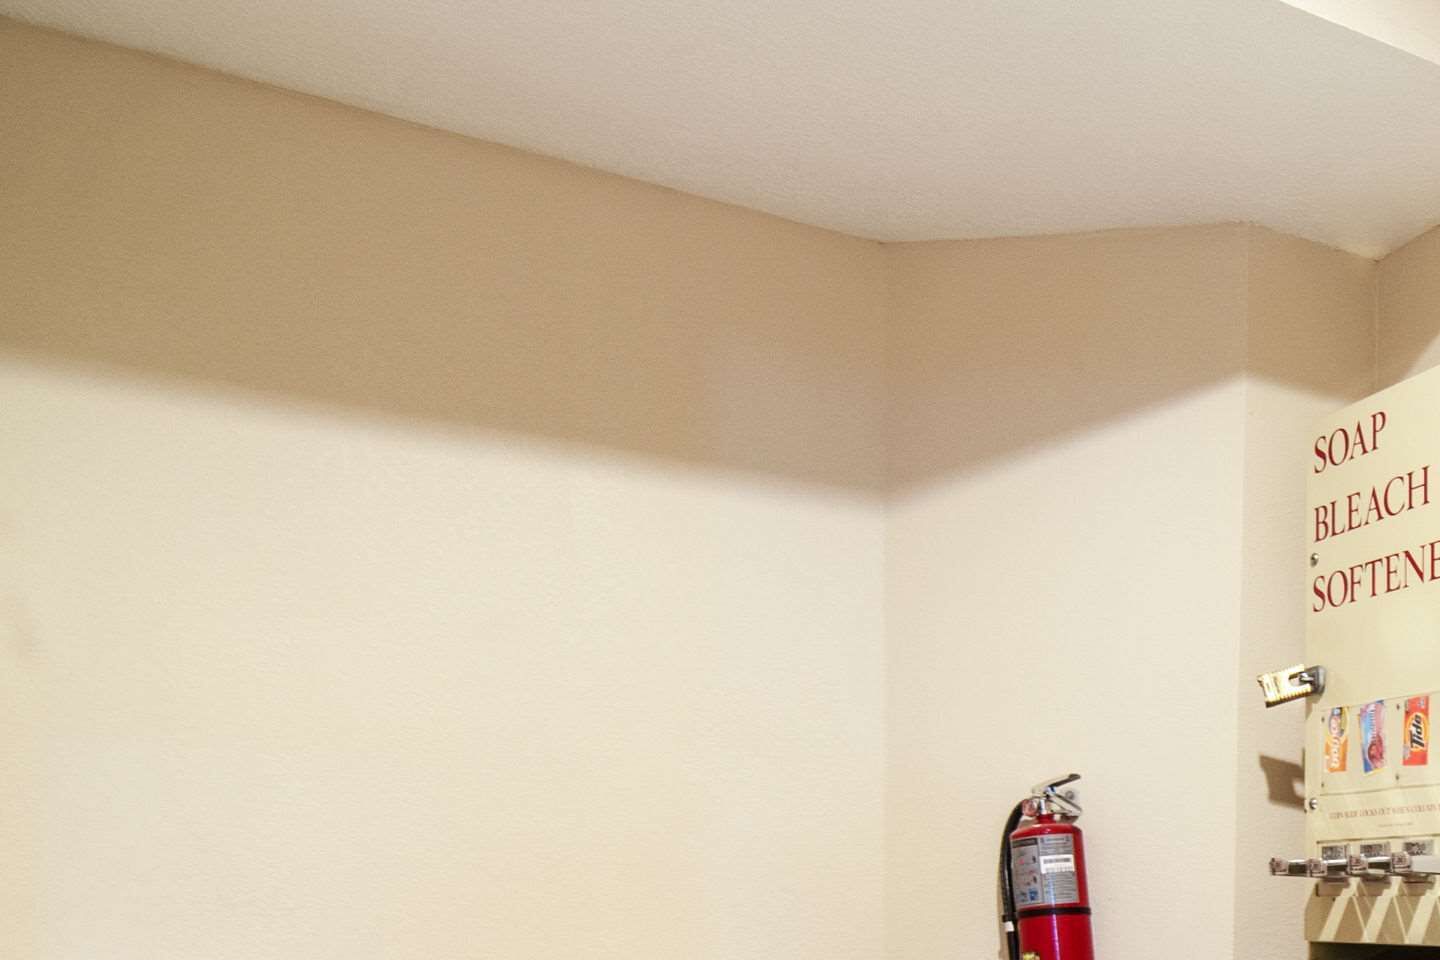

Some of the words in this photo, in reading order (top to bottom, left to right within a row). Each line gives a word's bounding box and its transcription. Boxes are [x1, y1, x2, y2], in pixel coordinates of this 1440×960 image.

[1314, 411, 1386, 474] SOAP
[1314, 465, 1430, 543] BLEACH
[1409, 714, 1425, 748] Tide
